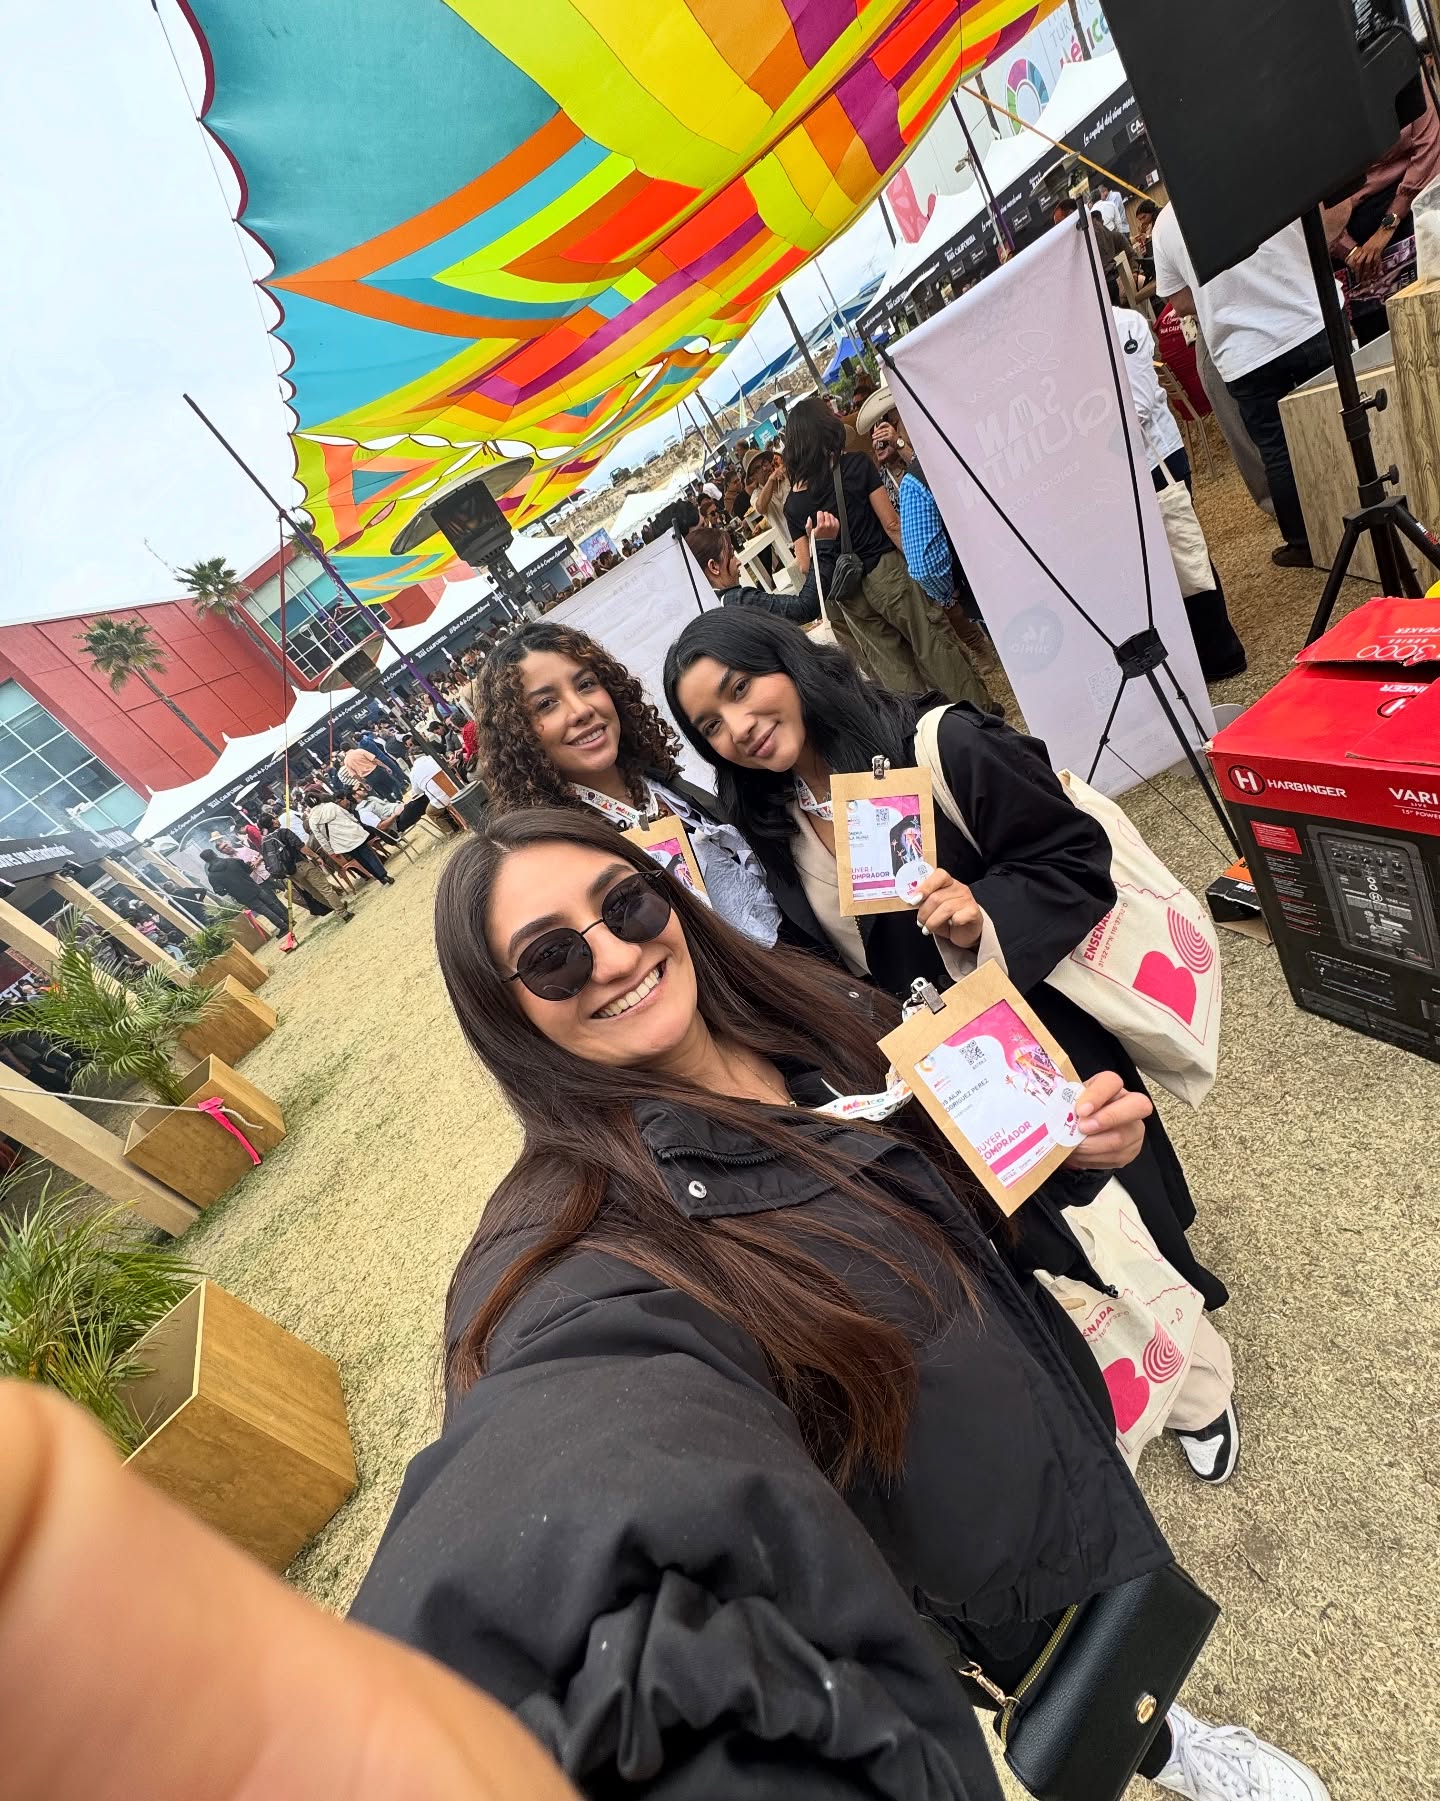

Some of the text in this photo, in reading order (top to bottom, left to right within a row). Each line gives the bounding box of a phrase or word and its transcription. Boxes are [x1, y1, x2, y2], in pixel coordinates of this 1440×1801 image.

[1395, 626, 1440, 634] PEAKER
[1379, 684, 1430, 693] INGER
[1266, 778, 1348, 798] HARBINGER
[852, 871, 890, 881] OMPRADOR
[1083, 907, 1115, 962] ENSENAD
[943, 1090, 973, 1112] ODRIGUEZ
[979, 1121, 1034, 1160] OMPRADOR
[1082, 1305, 1115, 1338] ENADA
